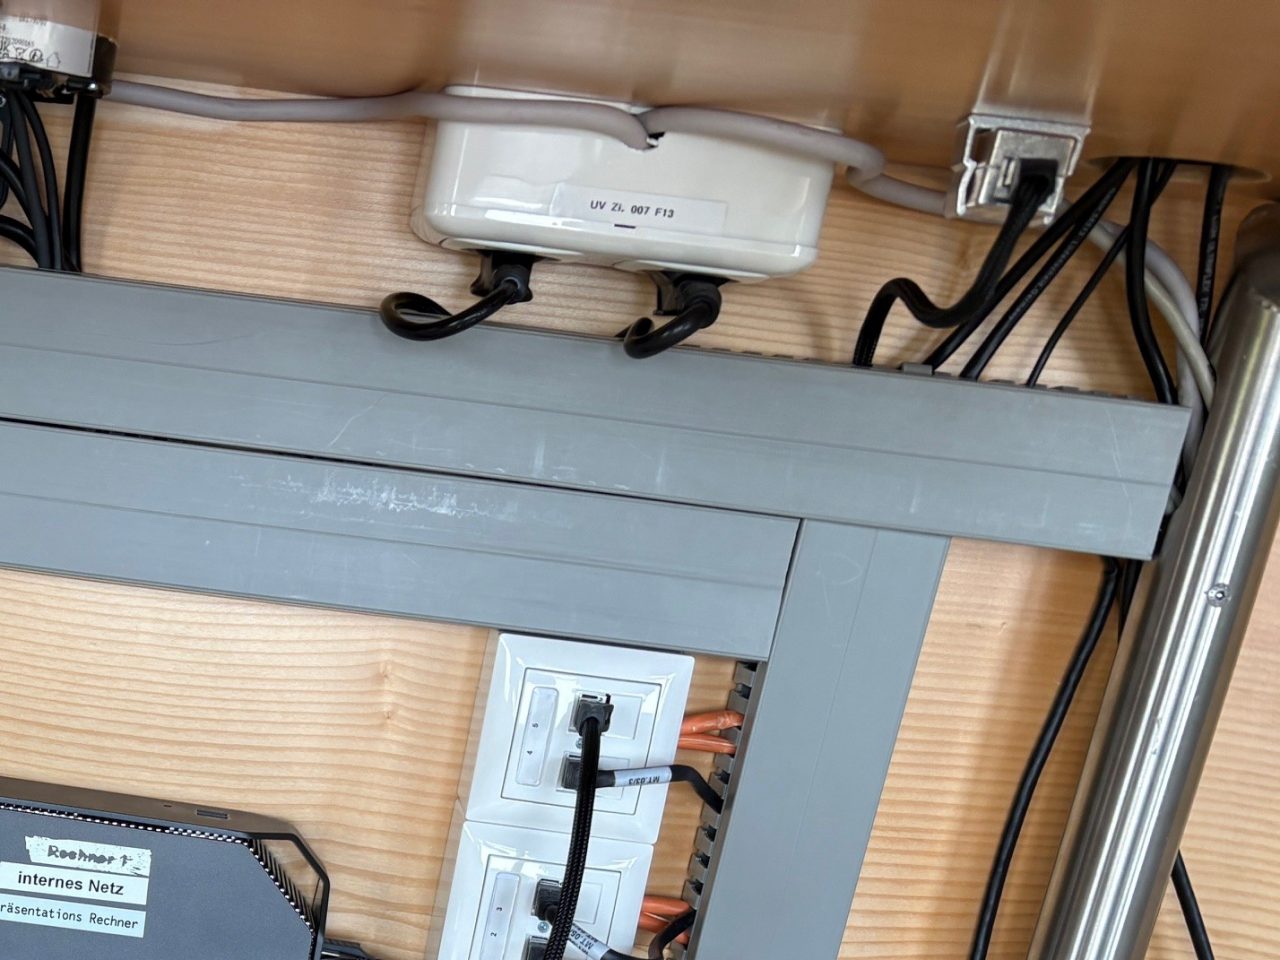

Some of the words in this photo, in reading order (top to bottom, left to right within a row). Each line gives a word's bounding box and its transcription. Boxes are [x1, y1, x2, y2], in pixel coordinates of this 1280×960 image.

[590, 200, 606, 210] UV
[611, 202, 624, 212] Zi.
[630, 204, 650, 215] 007
[654, 207, 674, 218] F13
[17, 870, 83, 891] internes
[87, 879, 124, 895] Netz
[89, 912, 138, 929] Rechner
